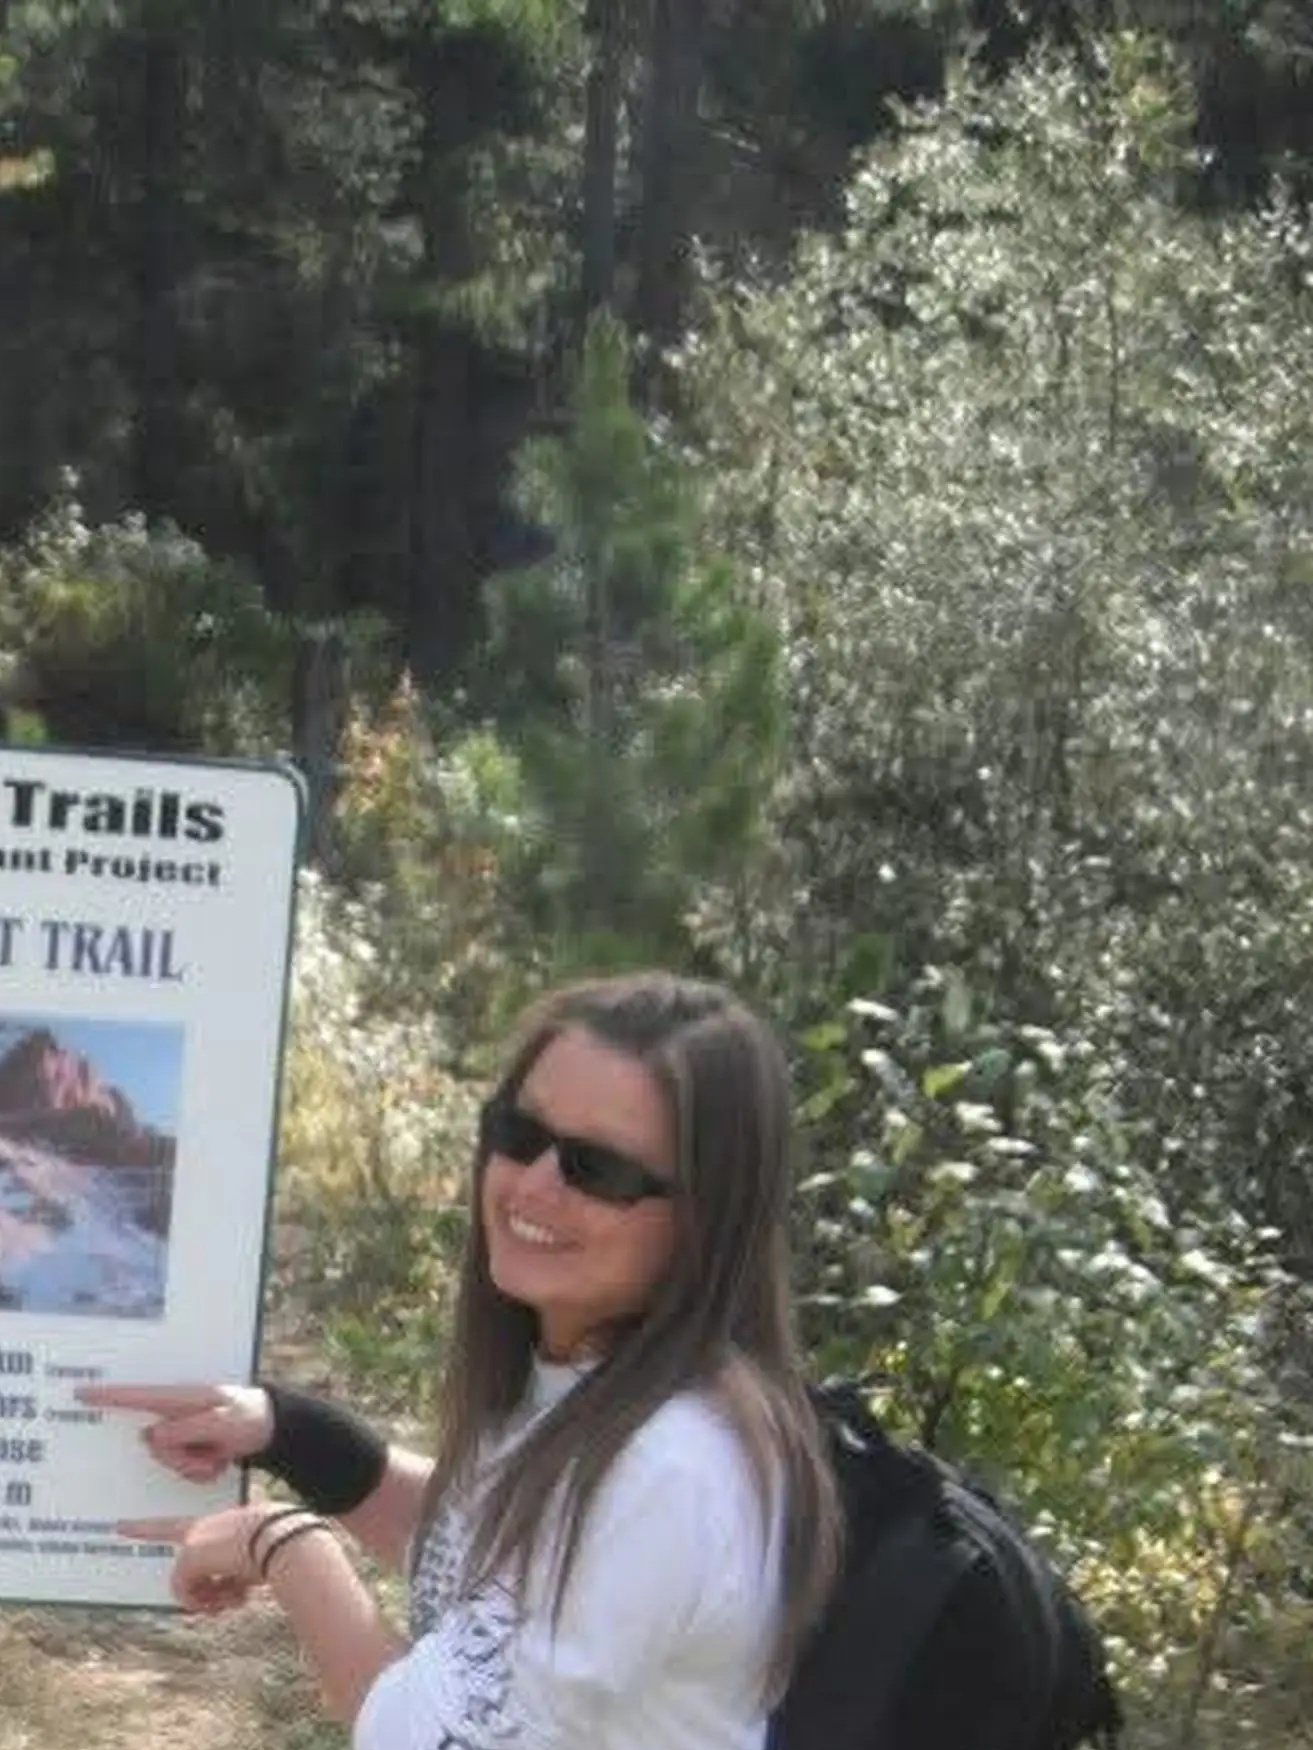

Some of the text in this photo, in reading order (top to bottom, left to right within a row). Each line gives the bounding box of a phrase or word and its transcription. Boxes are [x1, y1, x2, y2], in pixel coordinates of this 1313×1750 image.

[3, 780, 223, 842] Trails
[65, 849, 220, 886] Project
[41, 921, 182, 981] TRAIL
[5, 1481, 32, 1506] m
